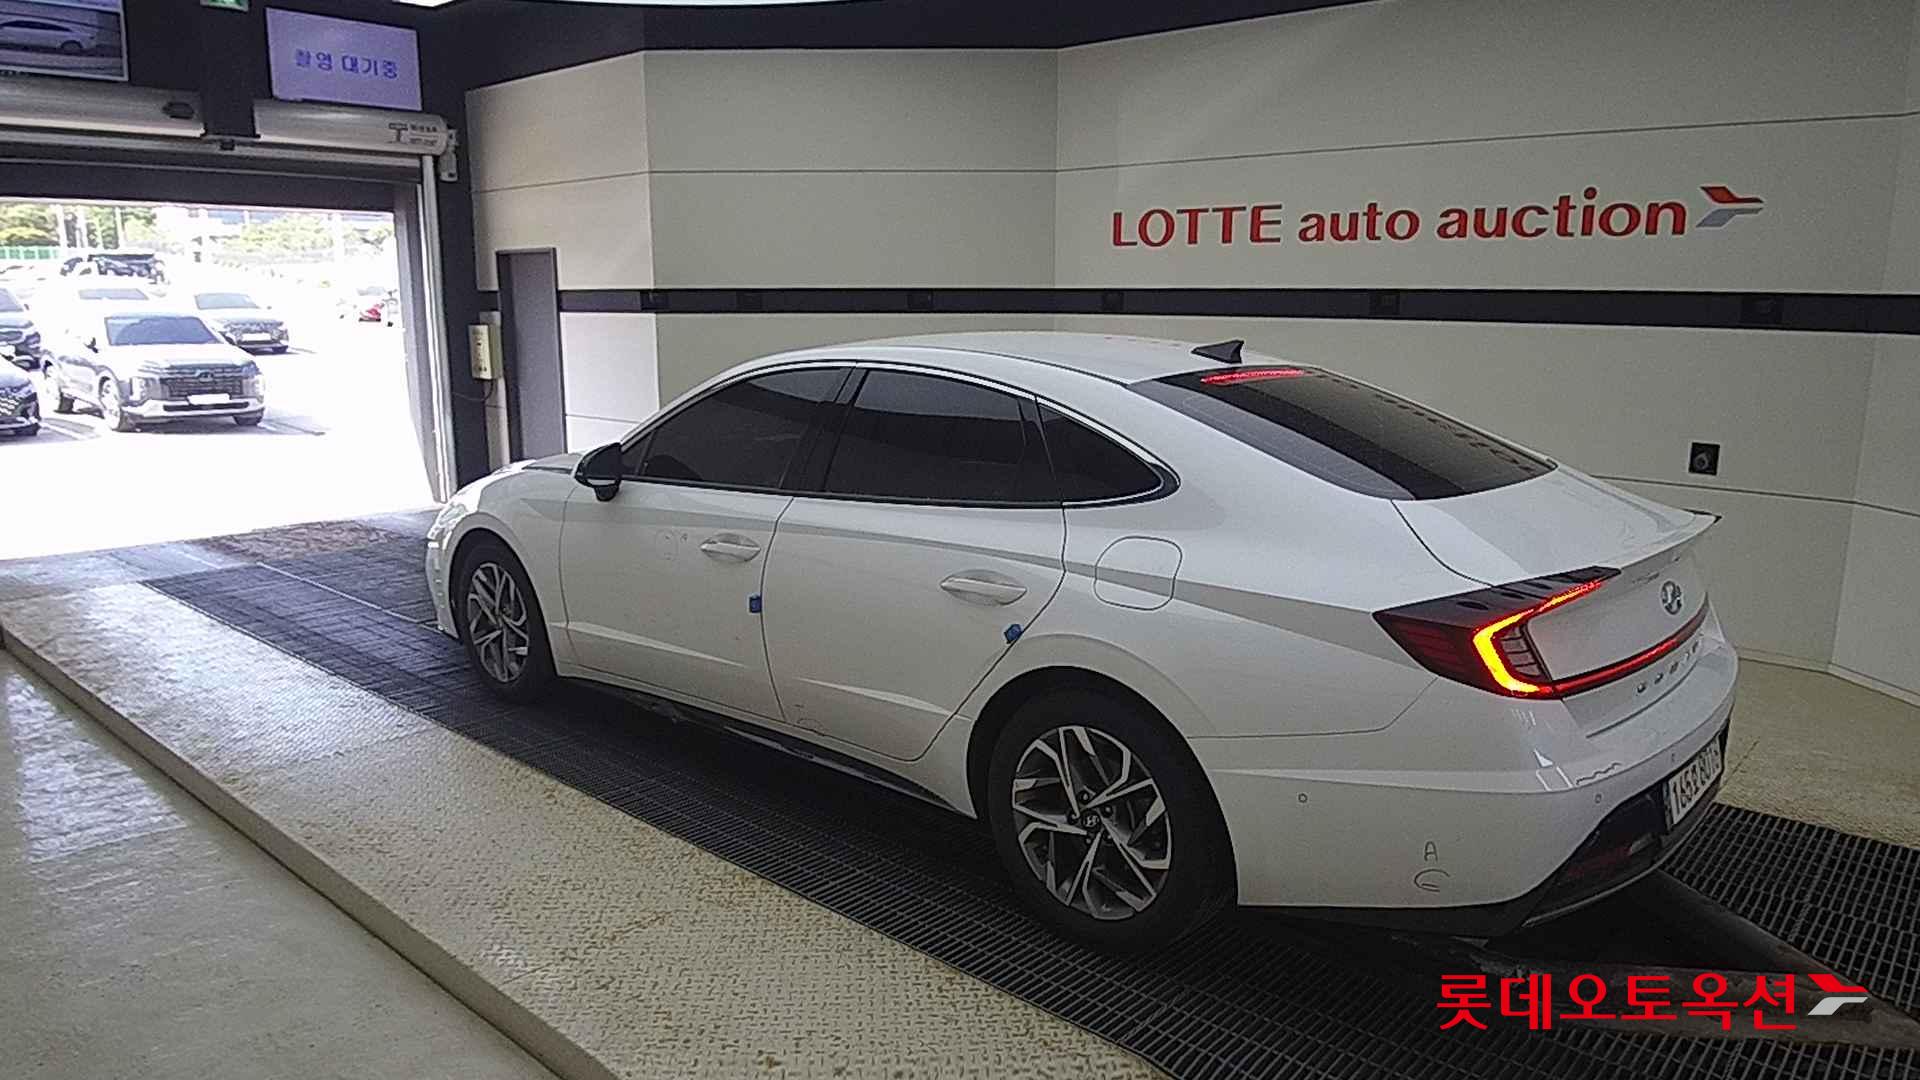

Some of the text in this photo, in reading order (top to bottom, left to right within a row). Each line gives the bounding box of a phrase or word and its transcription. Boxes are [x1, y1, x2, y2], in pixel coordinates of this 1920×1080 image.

[341, 55, 398, 79] 대기중
[1111, 187, 1687, 247] LOTTE auto auction
